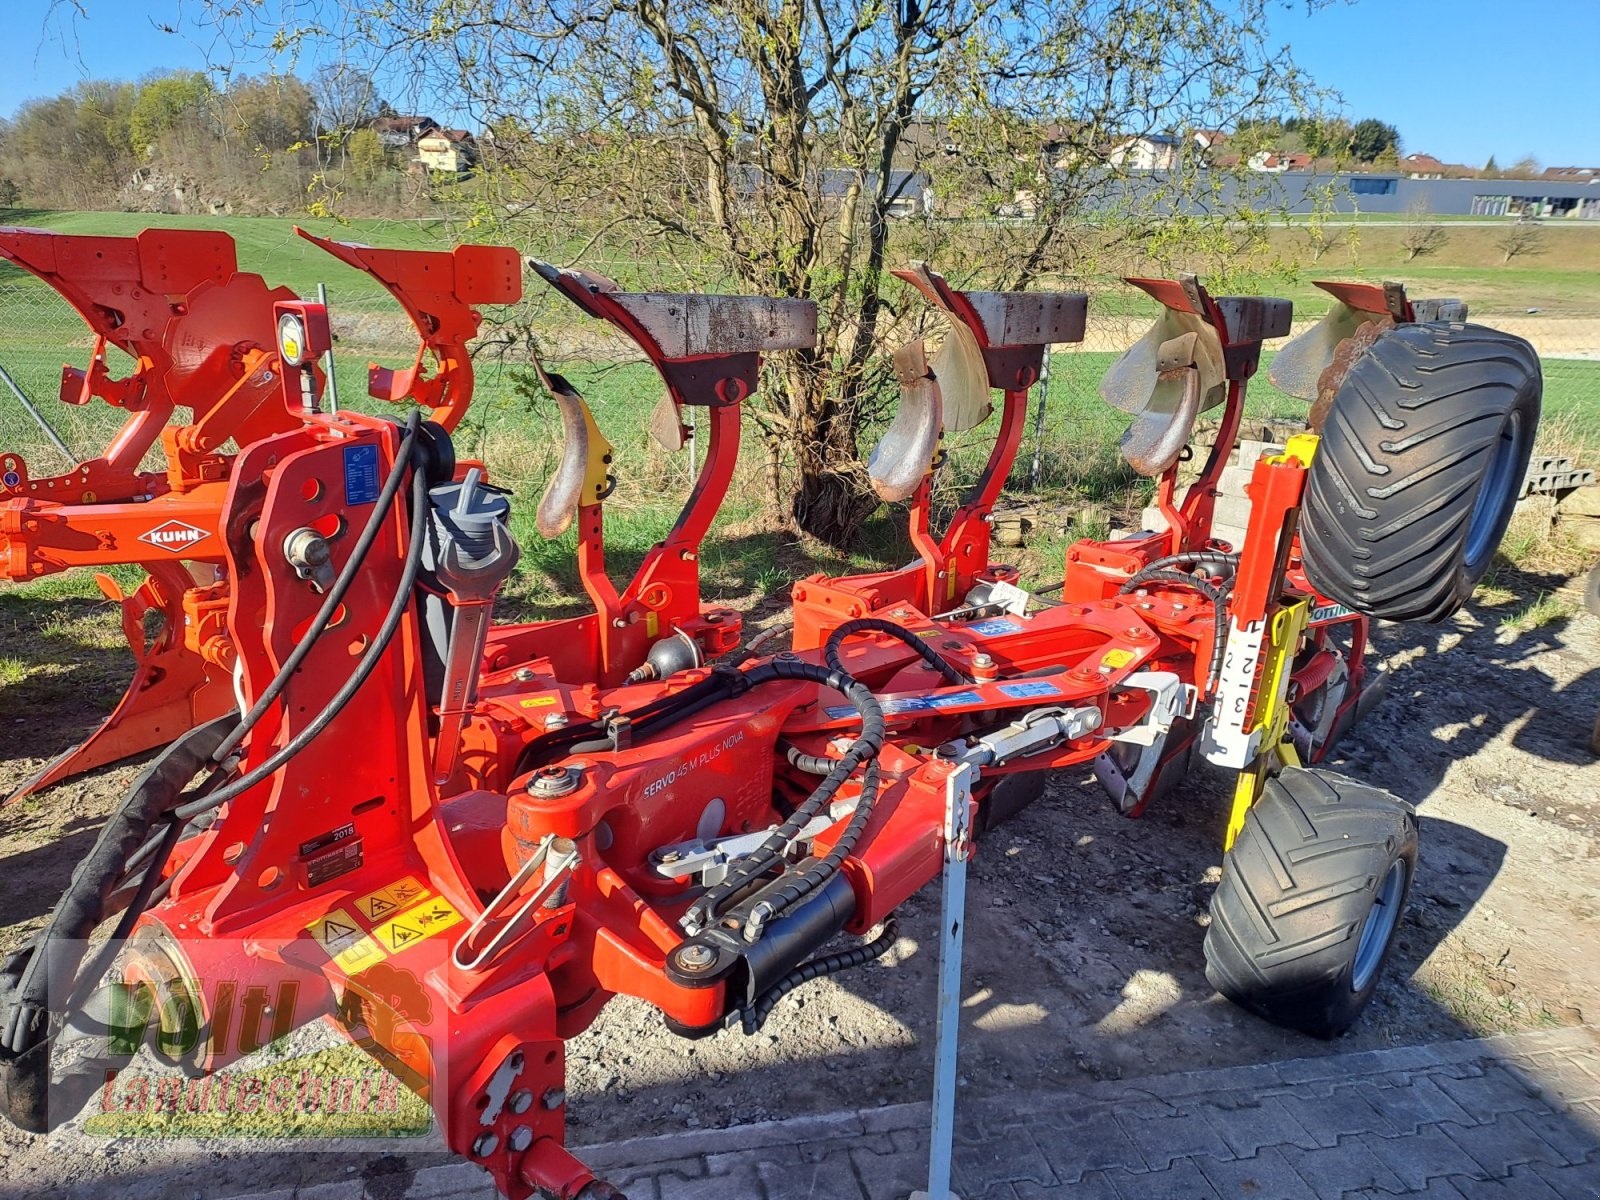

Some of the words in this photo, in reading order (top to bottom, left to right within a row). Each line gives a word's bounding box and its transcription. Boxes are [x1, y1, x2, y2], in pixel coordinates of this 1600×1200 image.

[150, 530, 199, 543] KUHN
[644, 771, 676, 797] SERVO
[677, 763, 688, 777] 45
[689, 756, 698, 771] M
[699, 744, 721, 766] PLUS
[722, 731, 744, 751] NOVA
[334, 827, 354, 841] 2018
